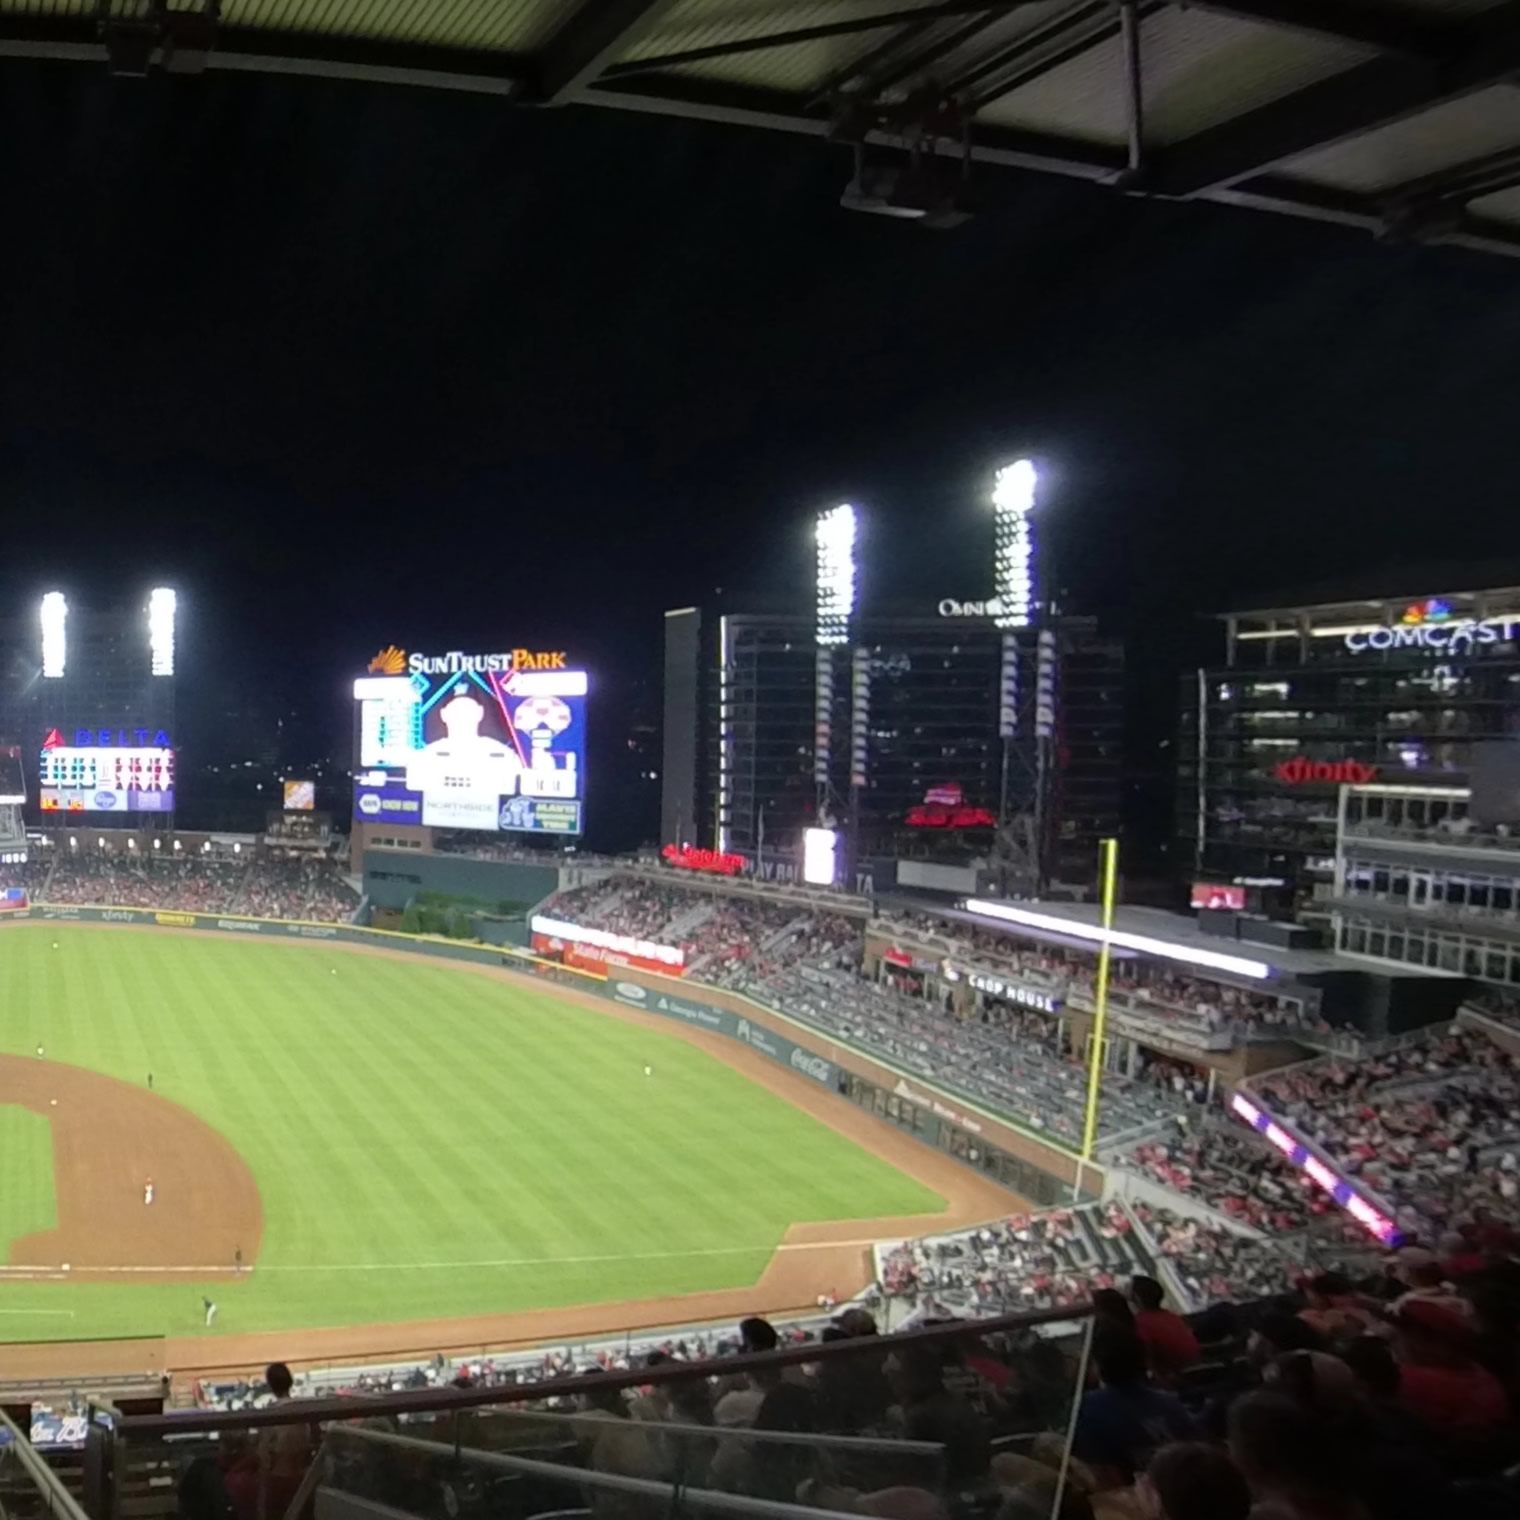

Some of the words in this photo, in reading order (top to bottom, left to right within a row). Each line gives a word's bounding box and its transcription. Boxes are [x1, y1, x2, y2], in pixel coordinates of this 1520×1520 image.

[1344, 621, 1514, 650] COMCAST
[74, 728, 171, 746] DELTA
[1272, 756, 1377, 784] xfinity
